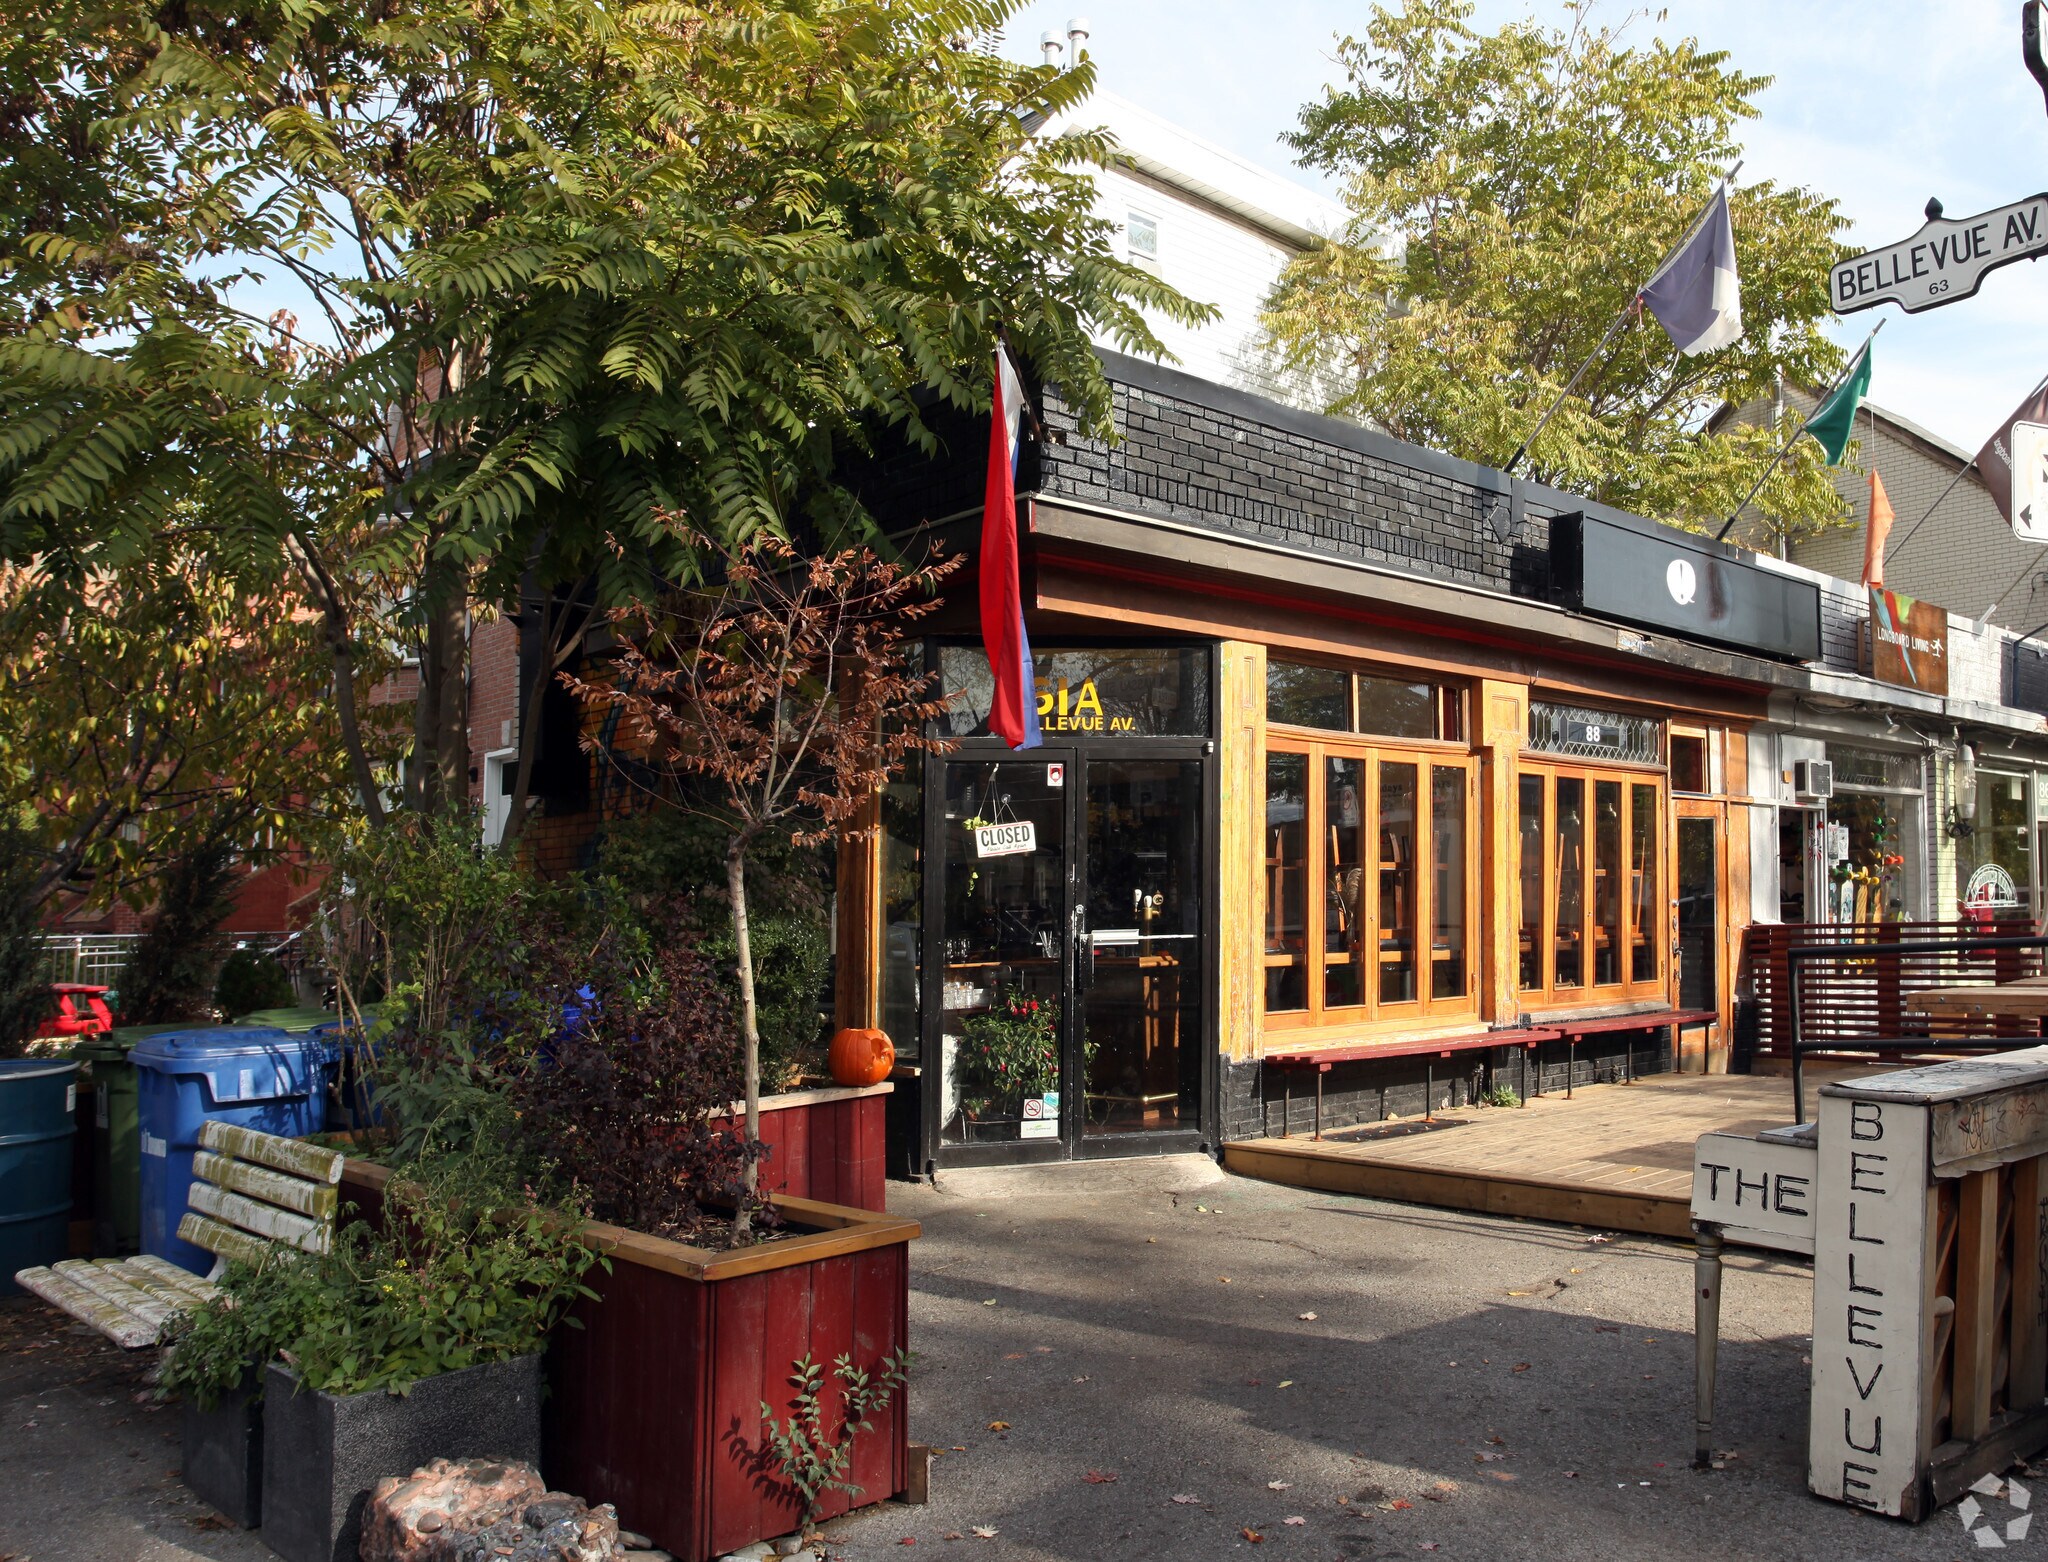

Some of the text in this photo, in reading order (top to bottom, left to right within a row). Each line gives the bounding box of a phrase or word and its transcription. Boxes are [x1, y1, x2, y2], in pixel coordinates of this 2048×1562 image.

[1838, 206, 2042, 301] BELLEVUE AV.
[1928, 279, 1949, 295] 63
[1040, 717, 1136, 731] LEVUE AV.
[1585, 725, 1600, 742] 88
[981, 825, 1030, 847] CLOSED
[1700, 1161, 1810, 1218] THE
[1842, 1101, 1888, 1509] BELLEVUE
